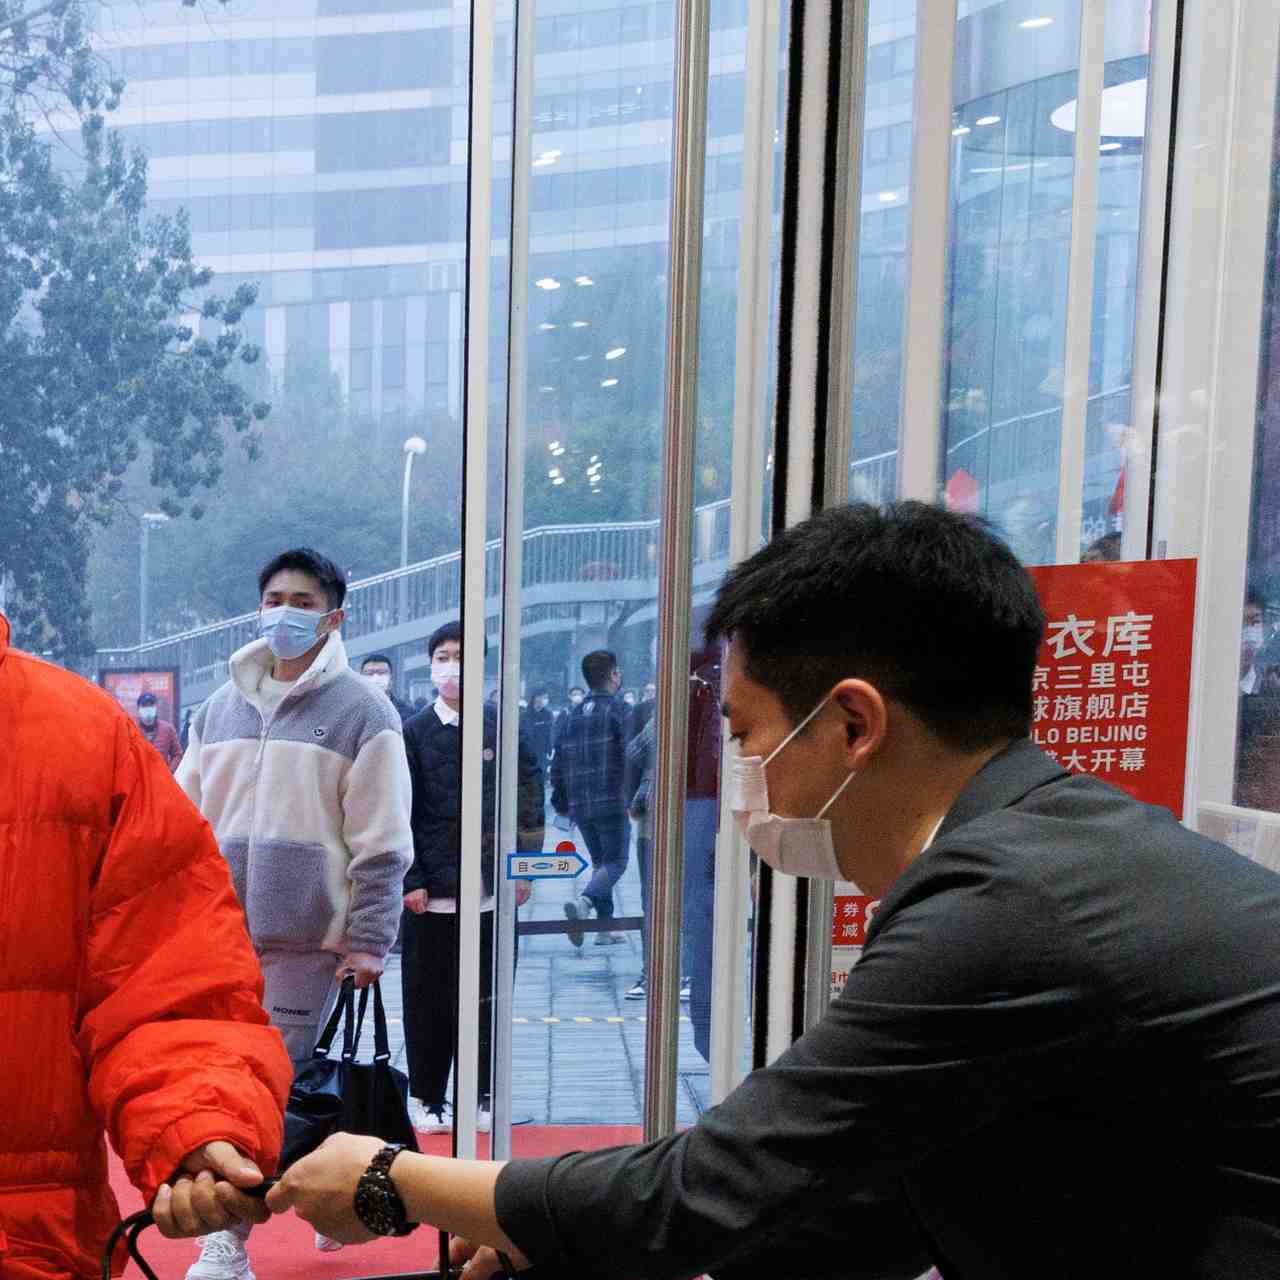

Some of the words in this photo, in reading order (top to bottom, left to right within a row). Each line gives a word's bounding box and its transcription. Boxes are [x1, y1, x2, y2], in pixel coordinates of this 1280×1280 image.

[1046, 611, 1153, 659] 衣库
[1031, 727, 1060, 745] LO
[1066, 724, 1148, 744] BEIJING
